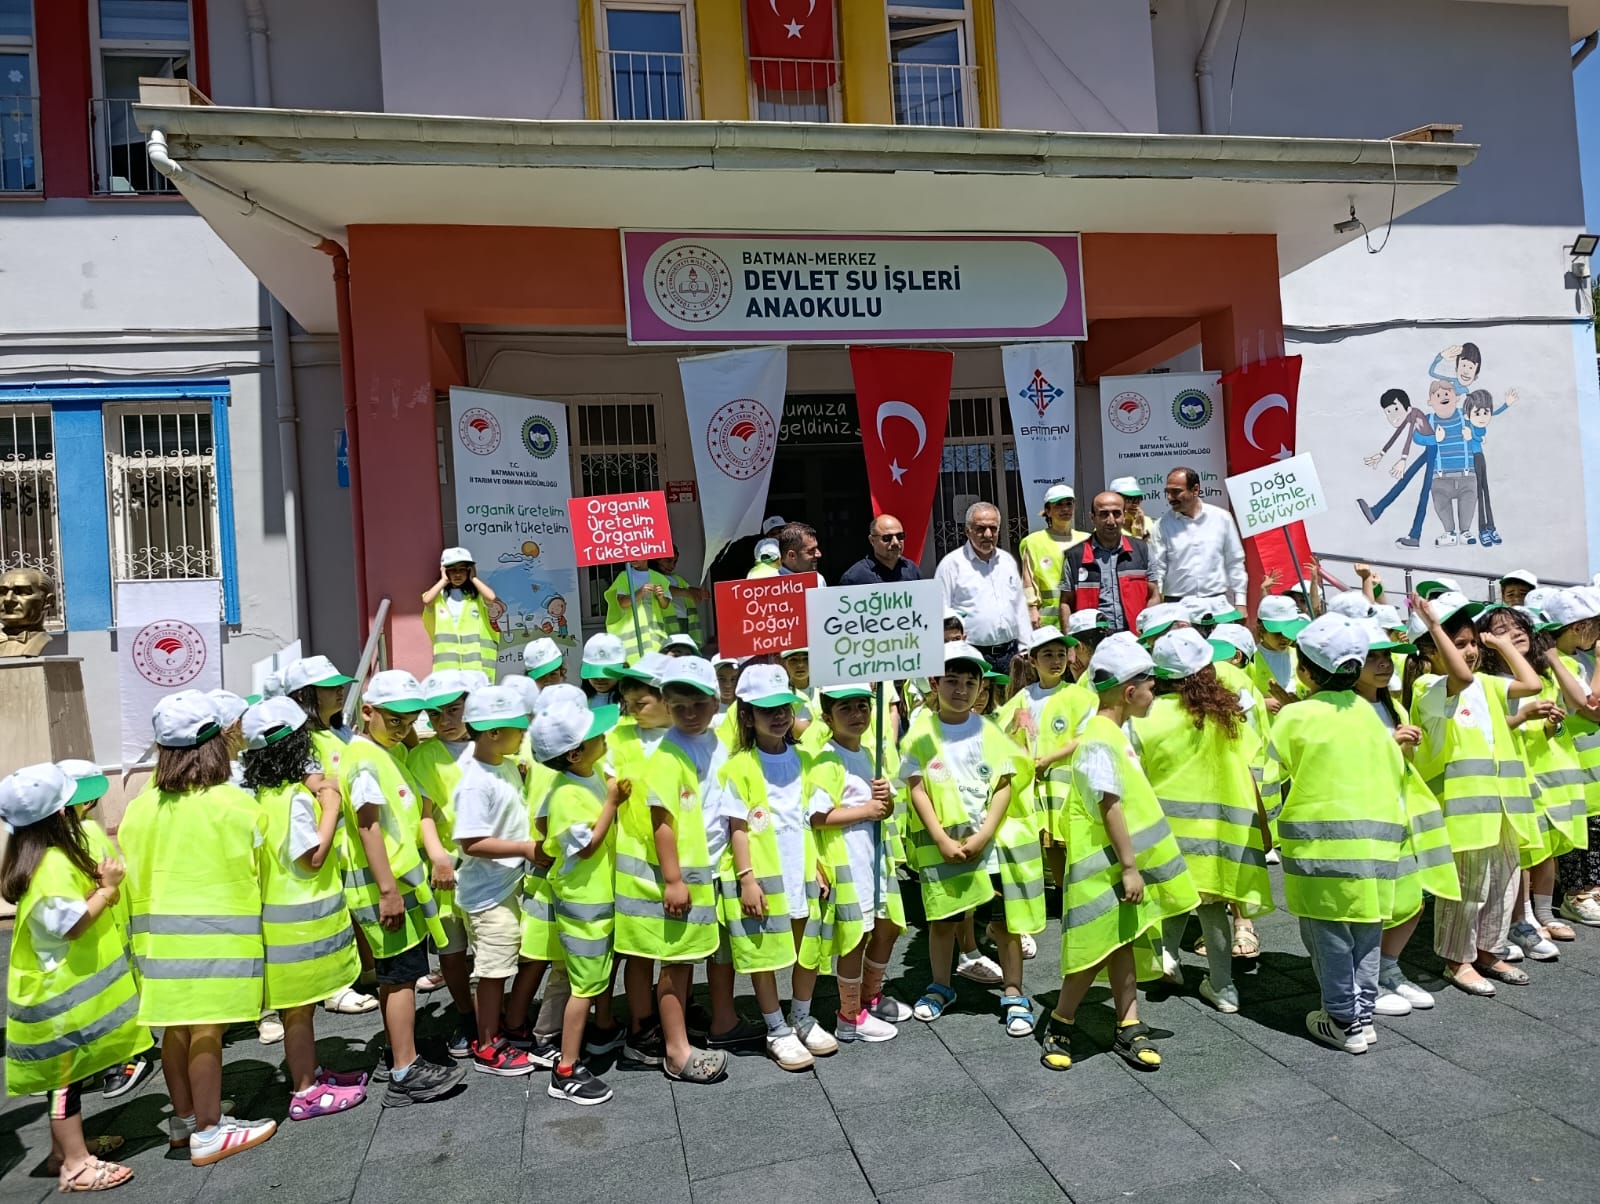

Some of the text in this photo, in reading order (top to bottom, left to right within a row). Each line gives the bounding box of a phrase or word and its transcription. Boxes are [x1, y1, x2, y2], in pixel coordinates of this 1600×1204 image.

[742, 252, 876, 266] BATMAN-MERKEZ
[744, 265, 960, 293] DEVLET SU İŞLERİ
[746, 296, 882, 318] ANAOKULU
[784, 403, 846, 416] umuza
[779, 418, 852, 441] geldiniz
[1020, 424, 1070, 436] BATMAN
[1250, 472, 1296, 495] Doğa
[587, 497, 650, 516] Organik
[1249, 486, 1306, 513] Bizimle
[467, 504, 564, 517] organik üretelim
[1246, 494, 1316, 528] Büyüyor!
[464, 520, 568, 535] organik tüketelim
[587, 514, 654, 531] Üretelim
[592, 527, 654, 545] Organik
[583, 540, 666, 561] Tüketelim!
[732, 580, 804, 600] Toprakla
[746, 601, 794, 617] Oyna,
[838, 591, 912, 615] Sağlıklı
[743, 615, 799, 634] Doğayı
[824, 610, 928, 635] Gelecek,
[754, 632, 792, 651] Koru!
[834, 632, 920, 658] Organik
[833, 653, 921, 677] Tarımla!
